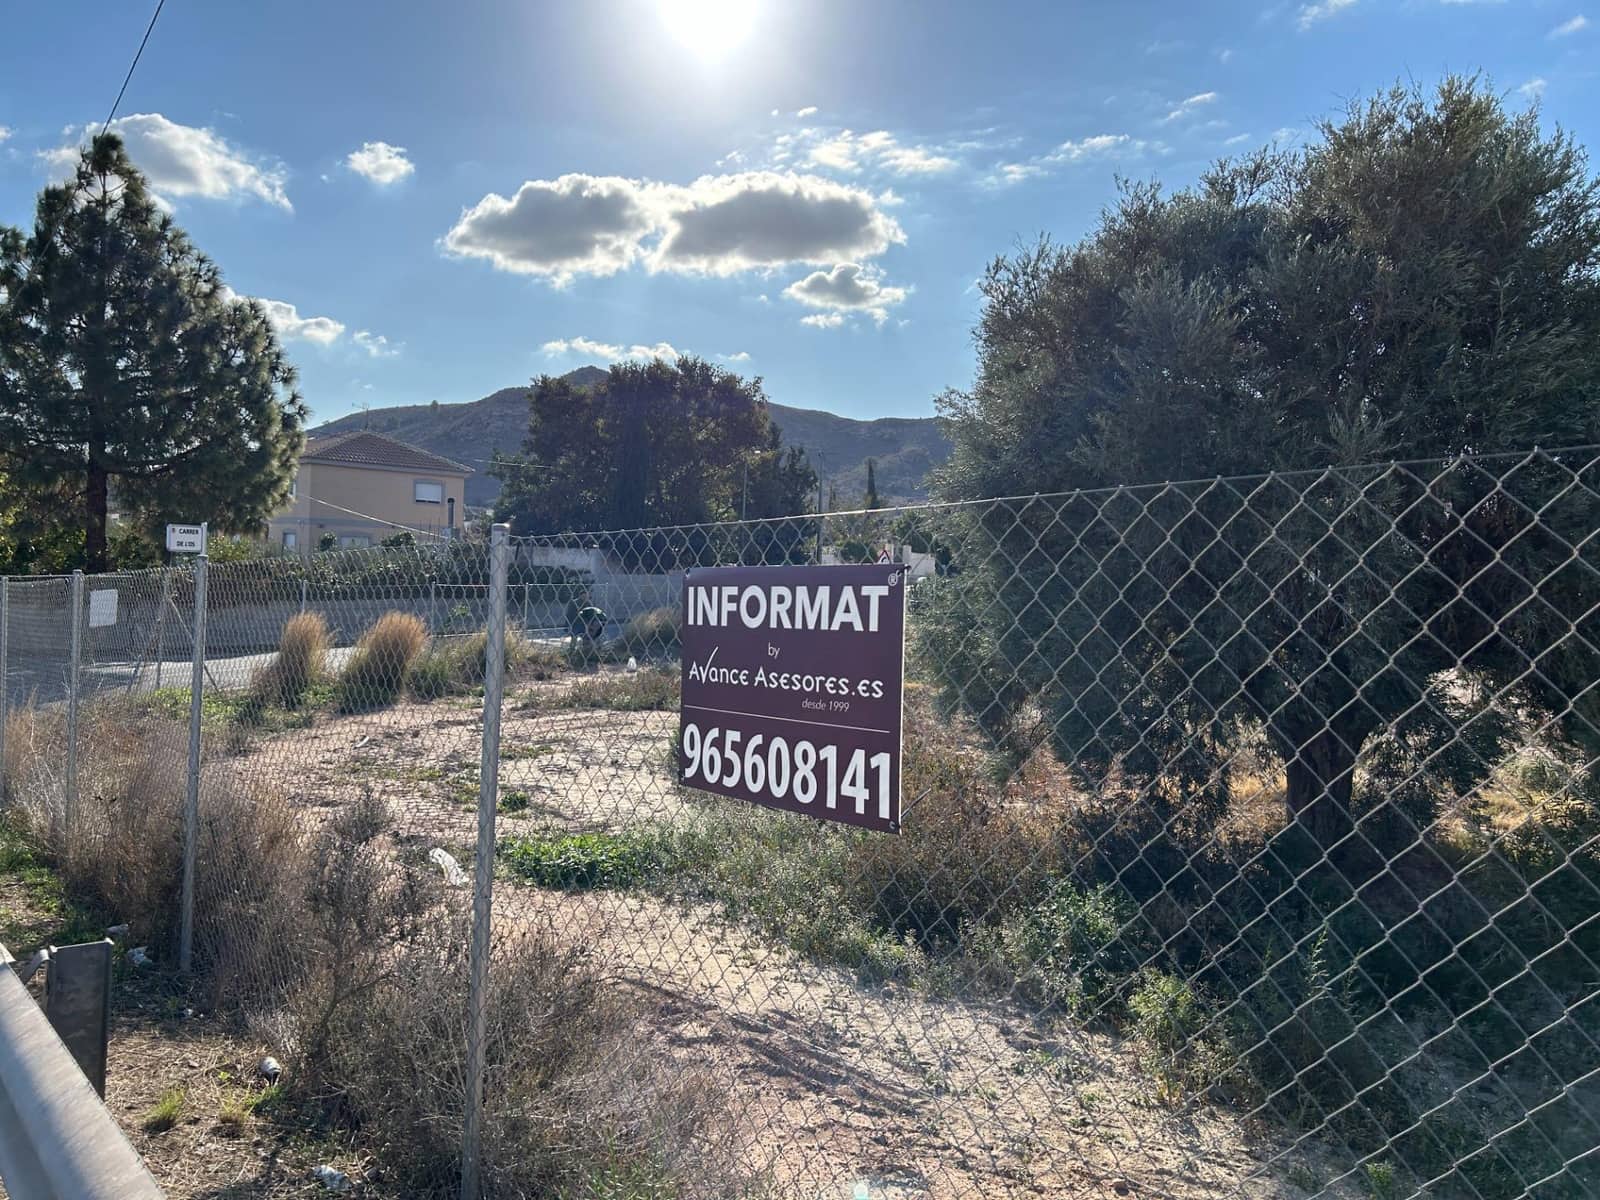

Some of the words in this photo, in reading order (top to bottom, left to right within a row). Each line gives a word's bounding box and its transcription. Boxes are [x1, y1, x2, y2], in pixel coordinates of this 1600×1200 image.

[687, 585, 889, 632] INFORMAT
[767, 643, 780, 659] by
[801, 698, 827, 711] desde
[829, 700, 850, 713] 1999
[683, 723, 891, 820] 965608141
